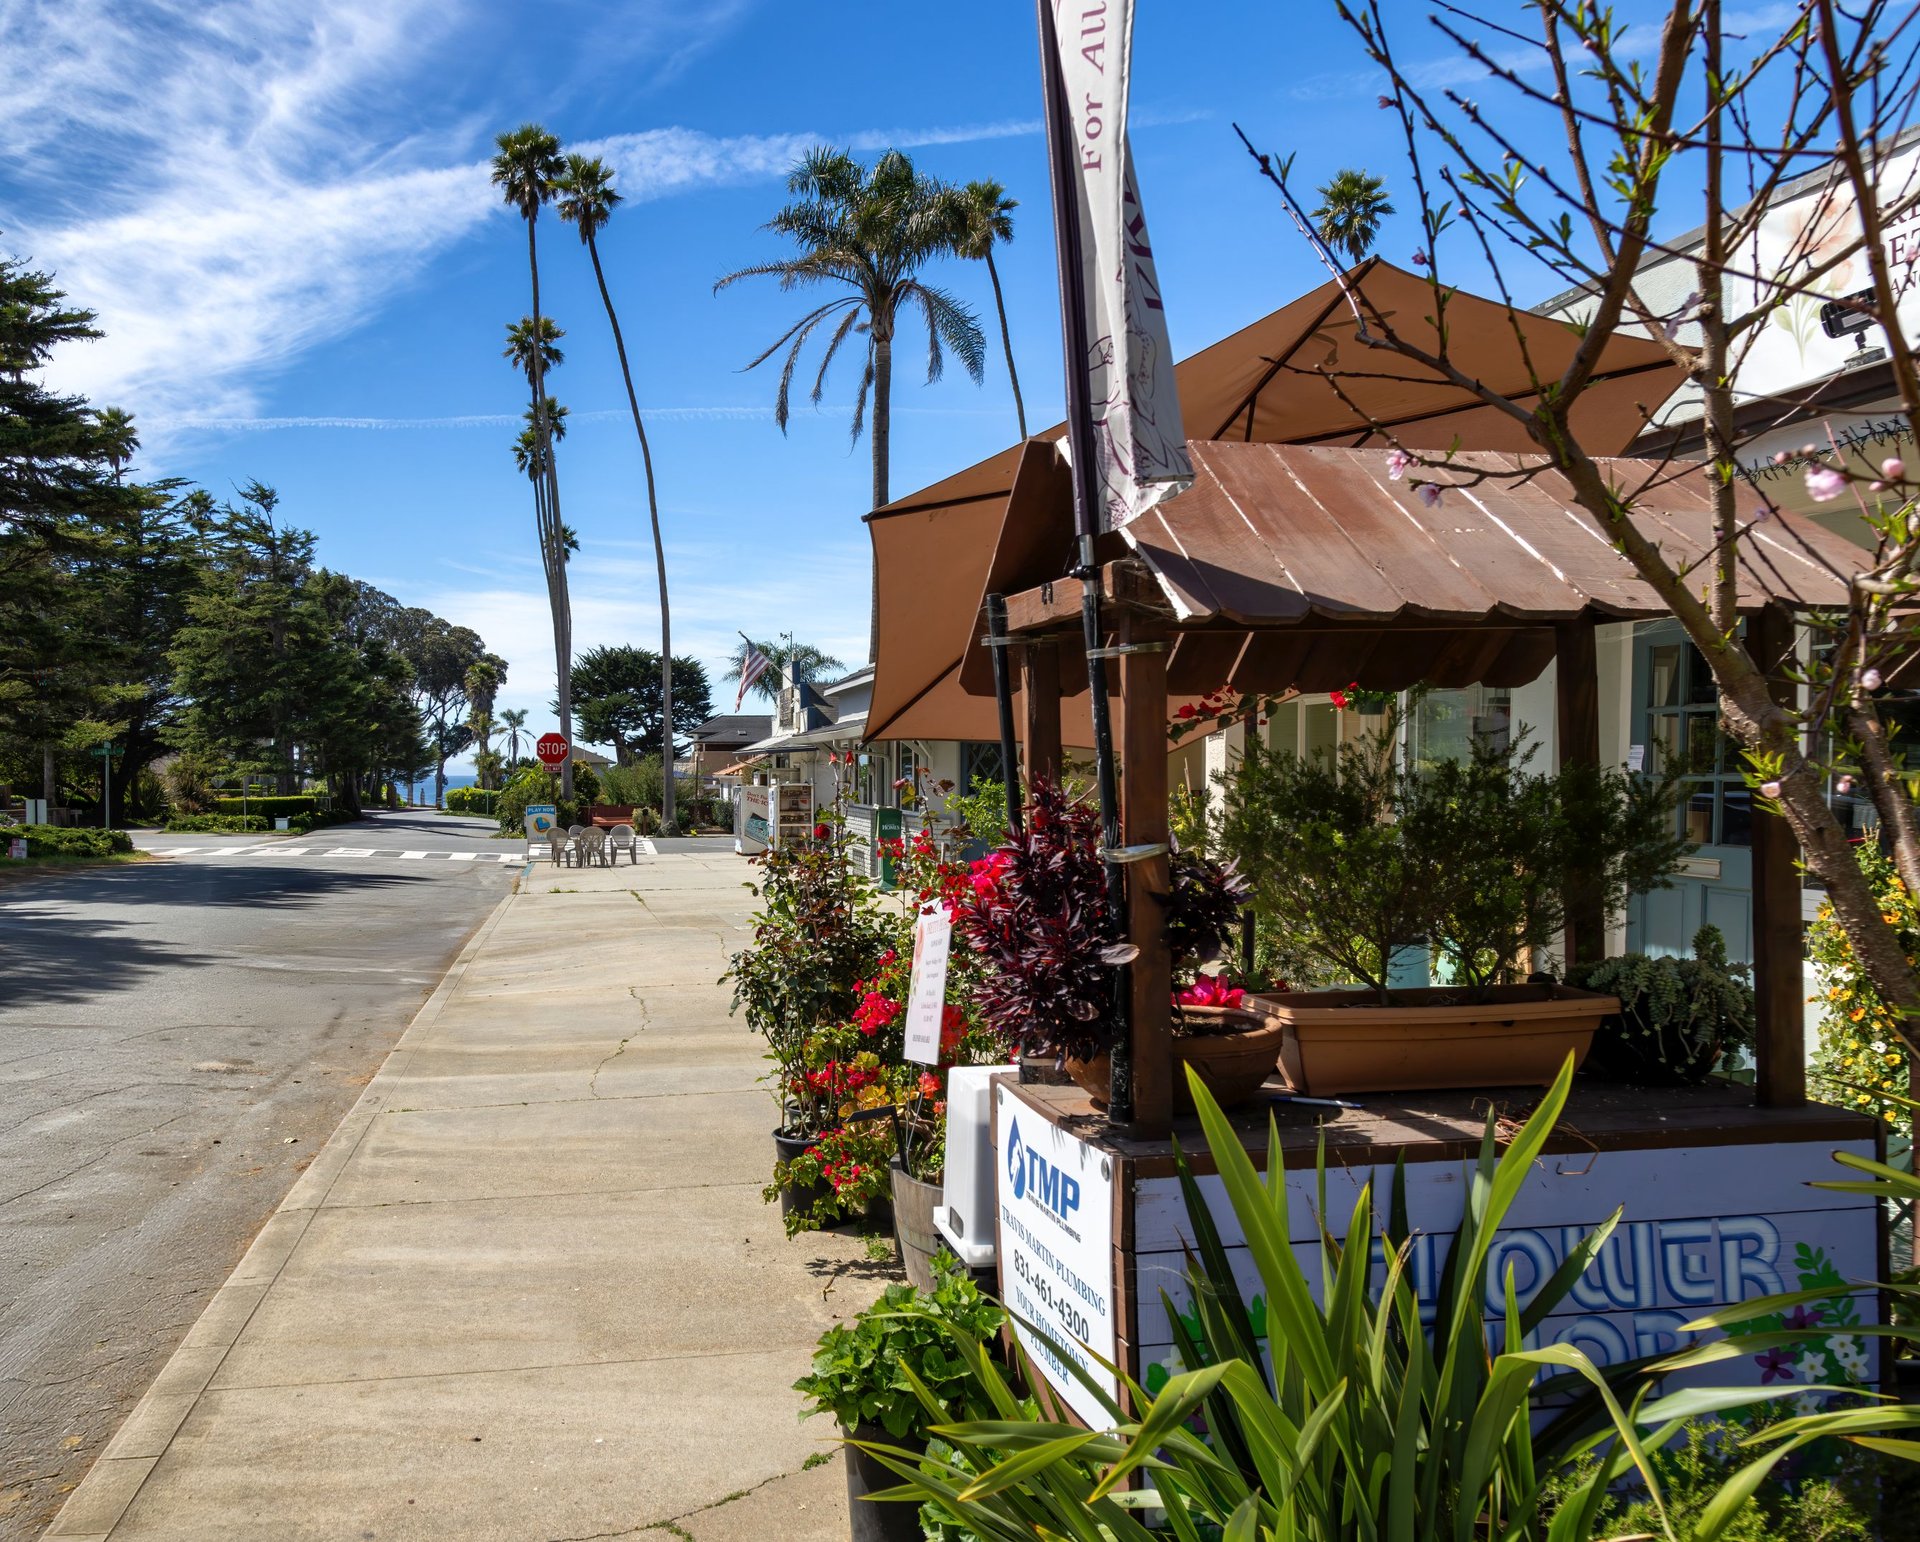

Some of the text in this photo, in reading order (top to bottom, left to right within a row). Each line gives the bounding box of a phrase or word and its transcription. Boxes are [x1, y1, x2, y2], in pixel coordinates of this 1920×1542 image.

[1081, 0, 1107, 173] For All
[538, 743, 567, 755] STOP
[1026, 1144, 1080, 1221] TMP
[1039, 1202, 1056, 1223] MARTIN
[1056, 1216, 1081, 1243] PLUMBING
[1002, 1204, 1106, 1317] TRAVIS MARTIN PLUMBING
[1014, 1249, 1090, 1344] 831-461-4300
[1016, 1285, 1035, 1322] YOUR
[1336, 1215, 1786, 1326] LOWER
